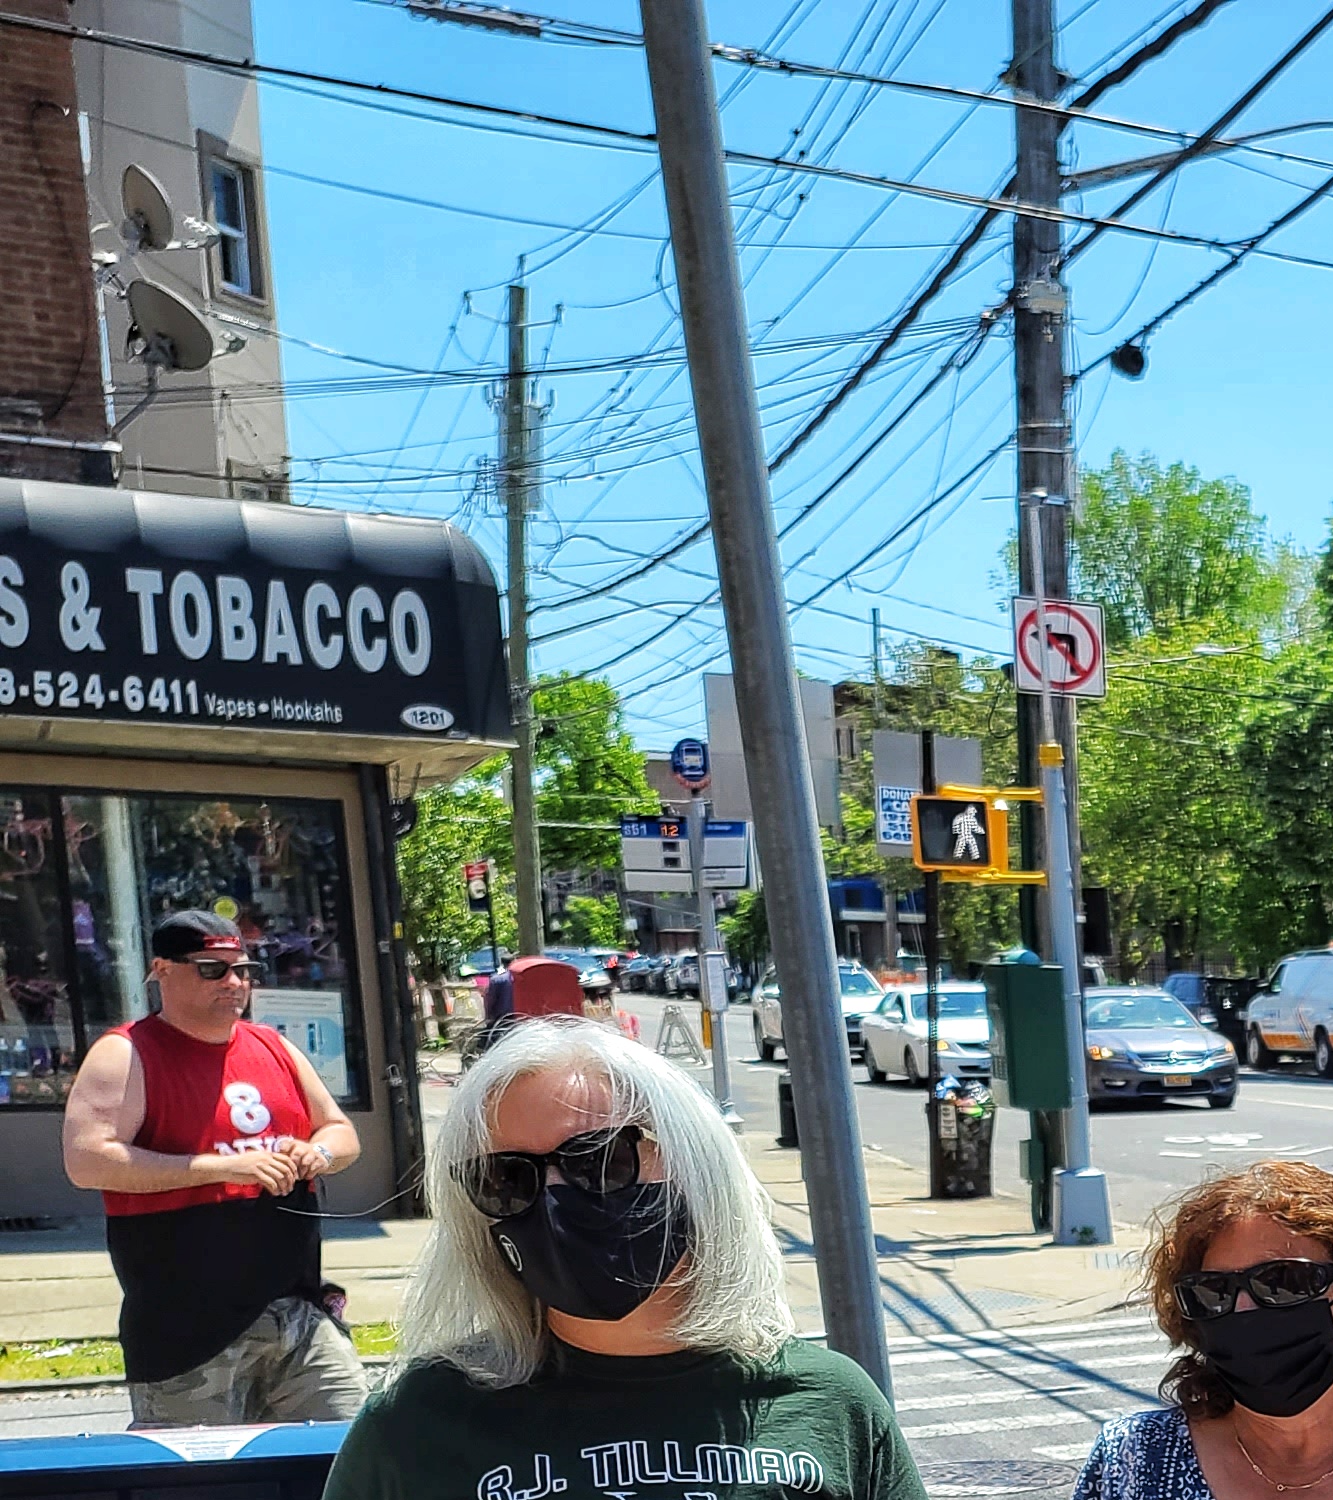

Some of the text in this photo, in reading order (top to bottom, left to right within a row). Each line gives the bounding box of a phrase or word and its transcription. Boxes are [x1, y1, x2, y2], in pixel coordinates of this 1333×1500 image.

[59, 560, 106, 652] &
[124, 566, 432, 676] TOBACCO
[204, 692, 343, 724] Vapes Hookahs
[409, 709, 446, 727] 1201
[223, 1082, 272, 1135] 8
[581, 1440, 825, 1495] TILLMAN
